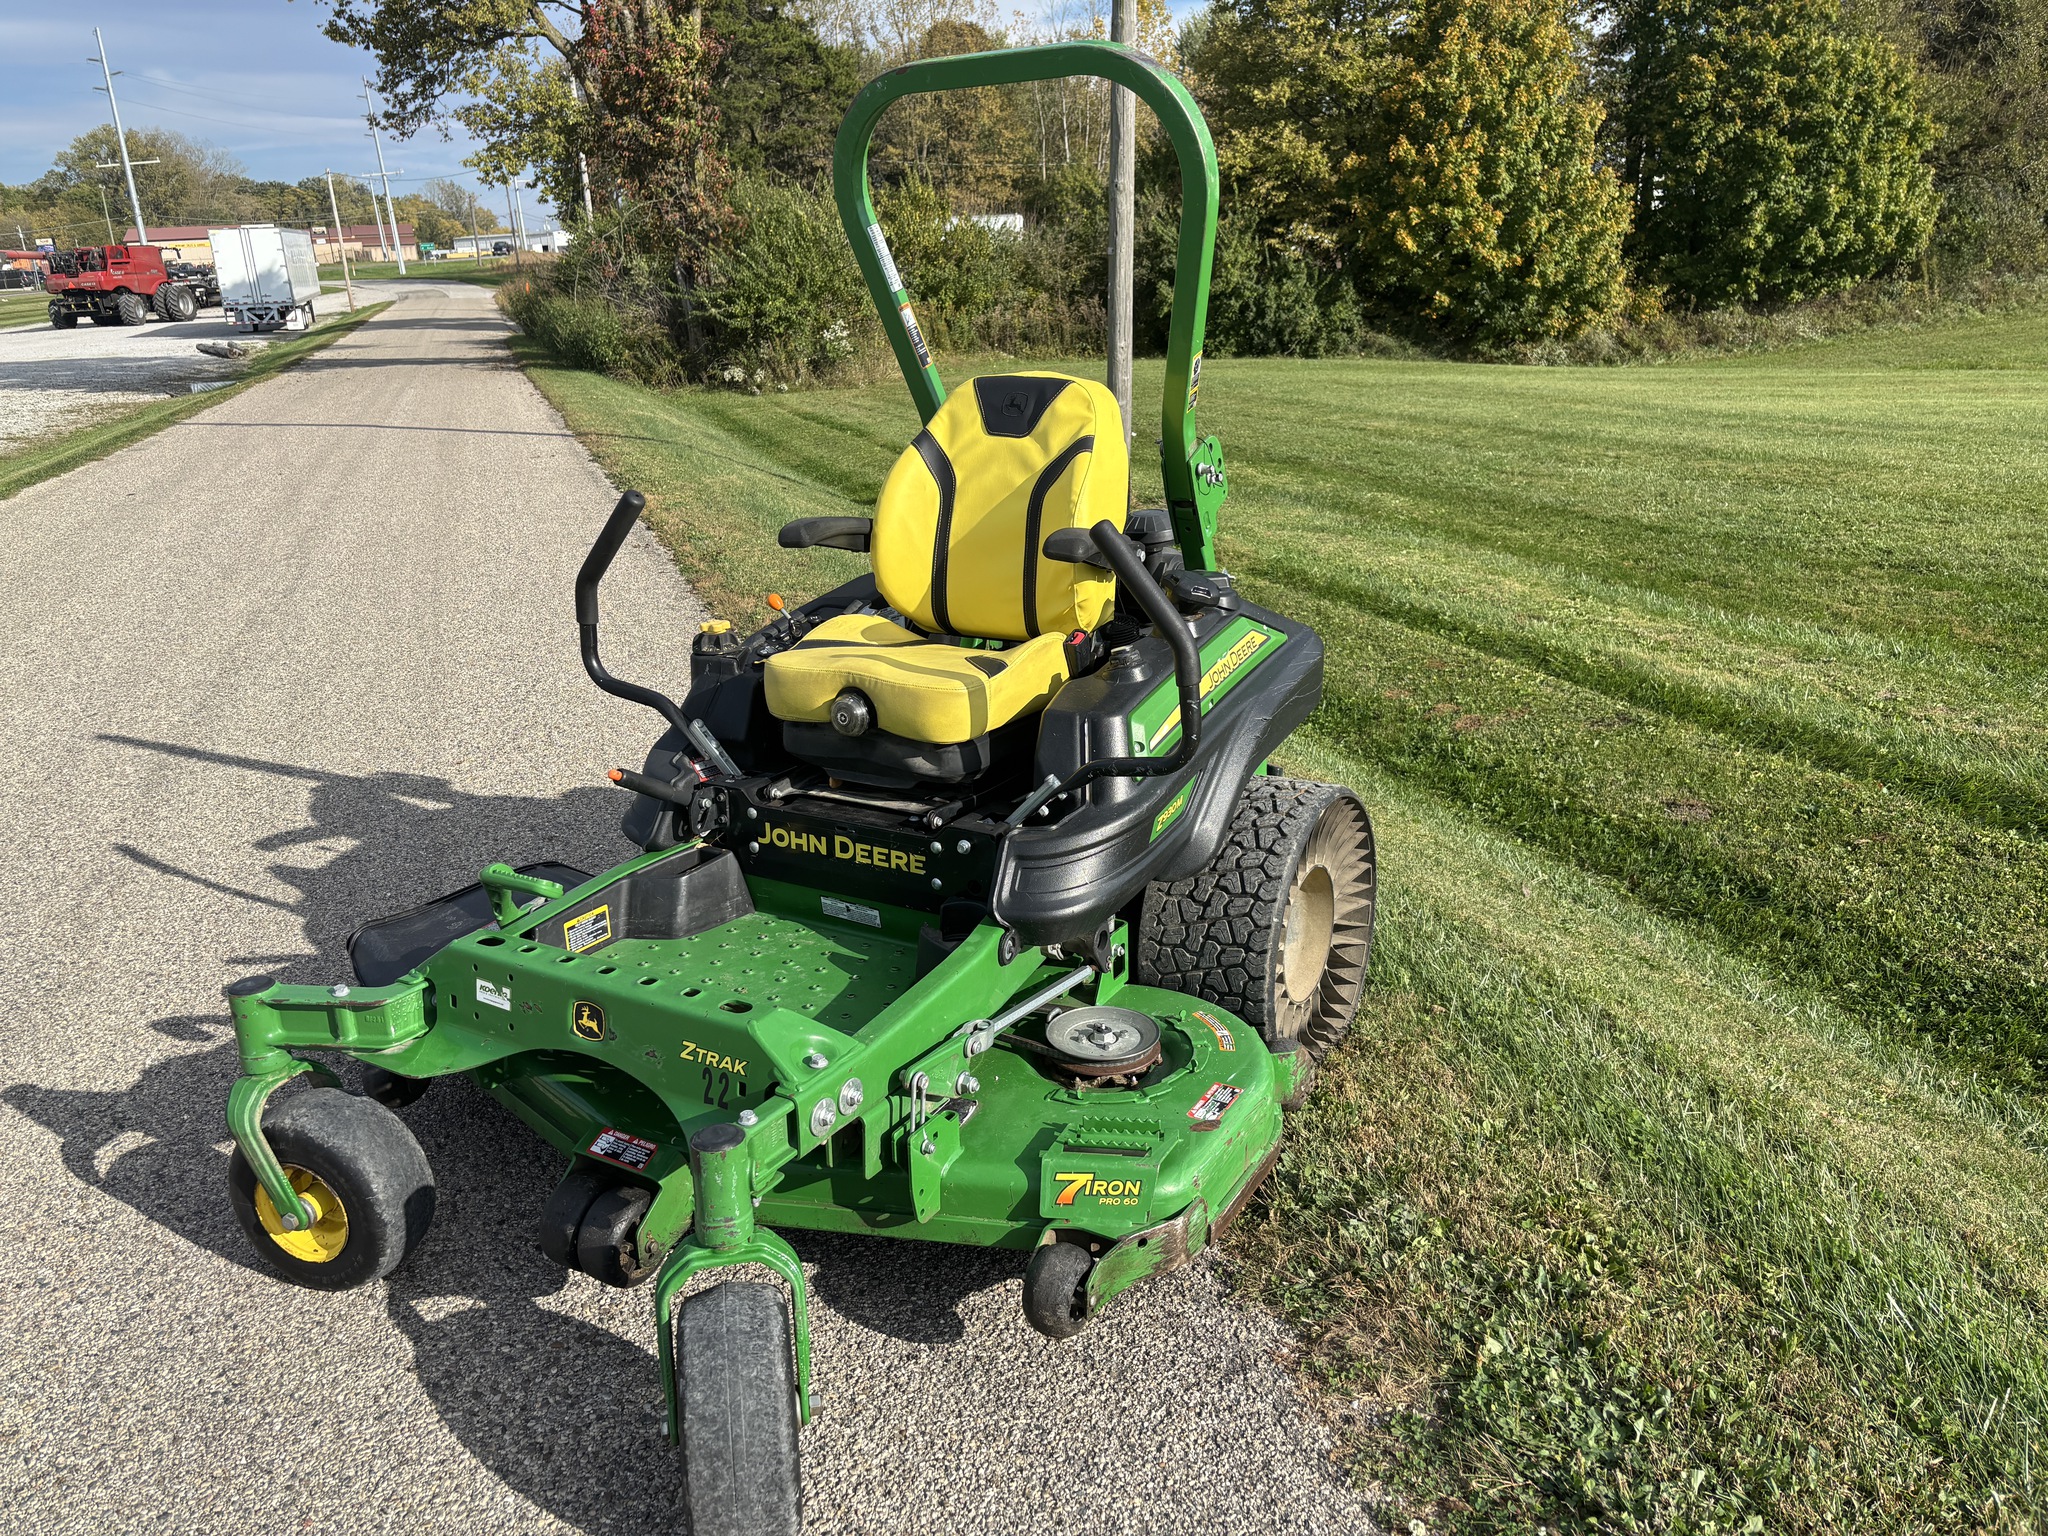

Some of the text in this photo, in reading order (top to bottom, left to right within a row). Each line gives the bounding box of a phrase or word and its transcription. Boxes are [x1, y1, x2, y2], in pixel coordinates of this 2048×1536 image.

[1208, 635, 1258, 690] JOHN DEERE
[1156, 794, 1184, 832] Z930M
[757, 821, 927, 876] JOHN DEERE
[679, 1040, 748, 1077] ZTRAK
[702, 1067, 730, 1111] 22
[613, 1130, 631, 1141] DANGER
[1098, 1197, 1139, 1206] PRO 60
